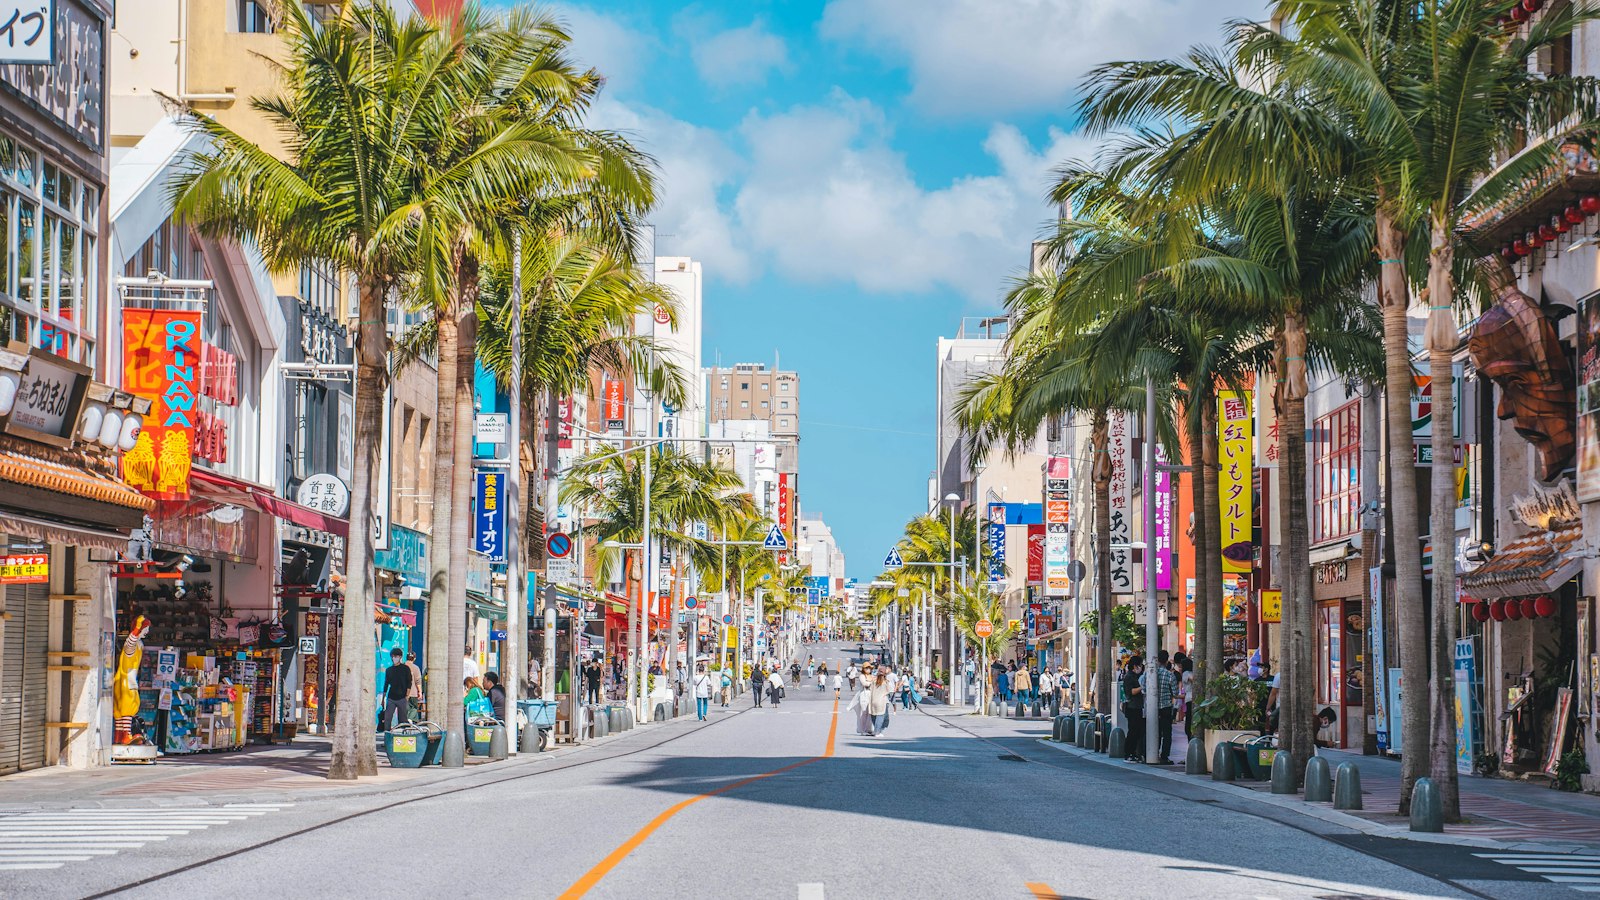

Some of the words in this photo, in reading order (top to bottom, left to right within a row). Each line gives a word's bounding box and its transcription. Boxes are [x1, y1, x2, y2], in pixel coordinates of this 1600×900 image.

[29, 374, 68, 417] ちぬまん
[161, 319, 196, 429] OKINAWA
[309, 480, 336, 496] 首里
[1223, 424, 1246, 540] 紅いもタルト
